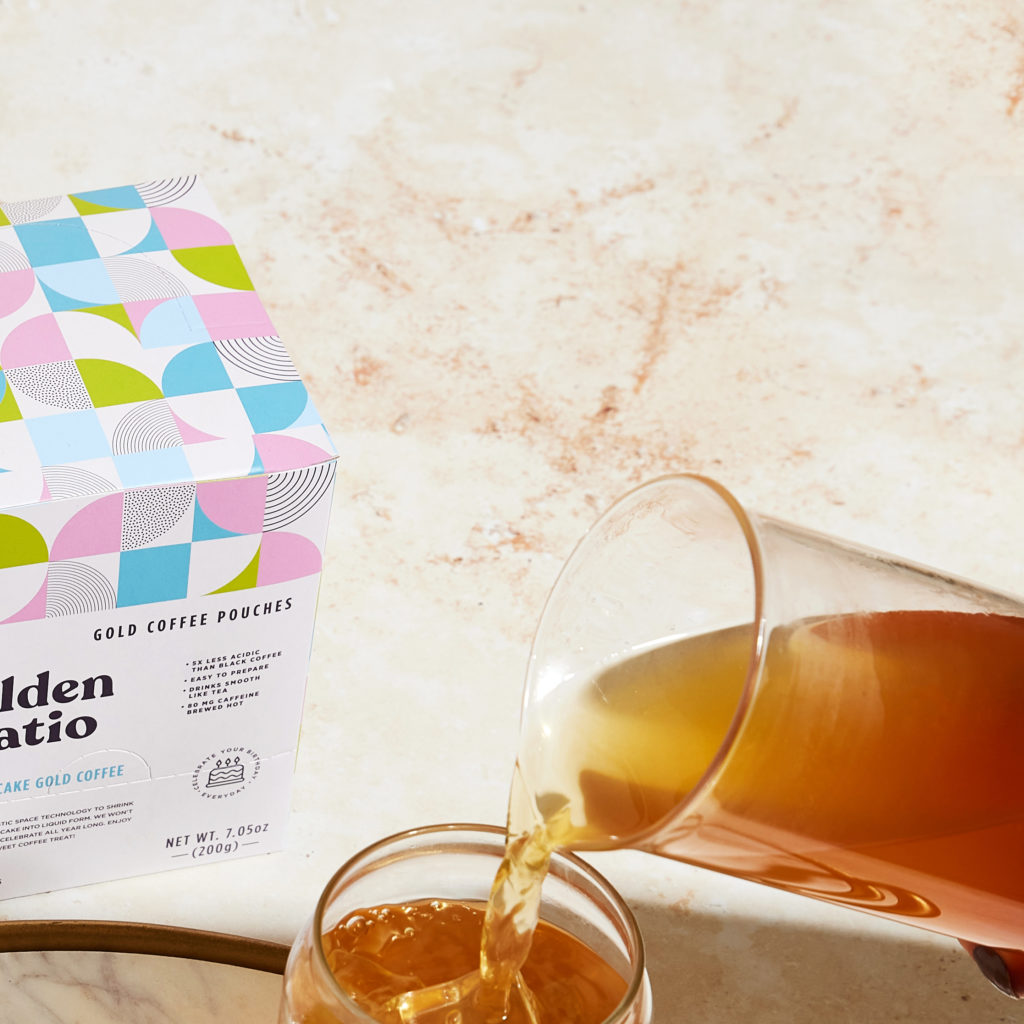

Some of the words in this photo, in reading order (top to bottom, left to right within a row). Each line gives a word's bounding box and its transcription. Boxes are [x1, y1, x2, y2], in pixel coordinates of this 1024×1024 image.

[93, 623, 137, 641] GOLD
[147, 613, 208, 634] COFFEE
[217, 597, 292, 623] POUCHES
[192, 664, 216, 673] THAN
[218, 659, 247, 669] BLACK
[250, 650, 282, 663] COFFEE
[206, 655, 227, 664] LESS
[231, 649, 260, 660] ACIDIC
[190, 674, 213, 683] EASY
[230, 663, 269, 676] PREPARE
[189, 682, 221, 692] DRINKS
[224, 675, 261, 687] SMOOTH
[188, 691, 208, 699] LIKE
[212, 687, 228, 695] TEA
[217, 690, 260, 704] CAFFEINE
[186, 704, 224, 715] BREWED
[226, 700, 244, 709] HOT
[35, 773, 72, 790] GOLD
[76, 764, 125, 783] COFFEE
[201, 785, 246, 800] EVERYDAY
[14, 815, 39, 824] SPACE
[41, 807, 92, 820] TECHNOLOGY
[106, 800, 134, 810] SHRINK
[0, 826, 21, 835] CAKE
[22, 823, 41, 831] INTO
[41, 819, 67, 828] LIQUID
[108, 808, 134, 817] WON'T
[0, 832, 43, 843] CELEBRATE
[107, 817, 132, 826] ENJOY
[17, 838, 48, 848] COFFEE
[165, 835, 190, 849] NET
[196, 831, 219, 844] WT.
[192, 841, 239, 859] (200g)
